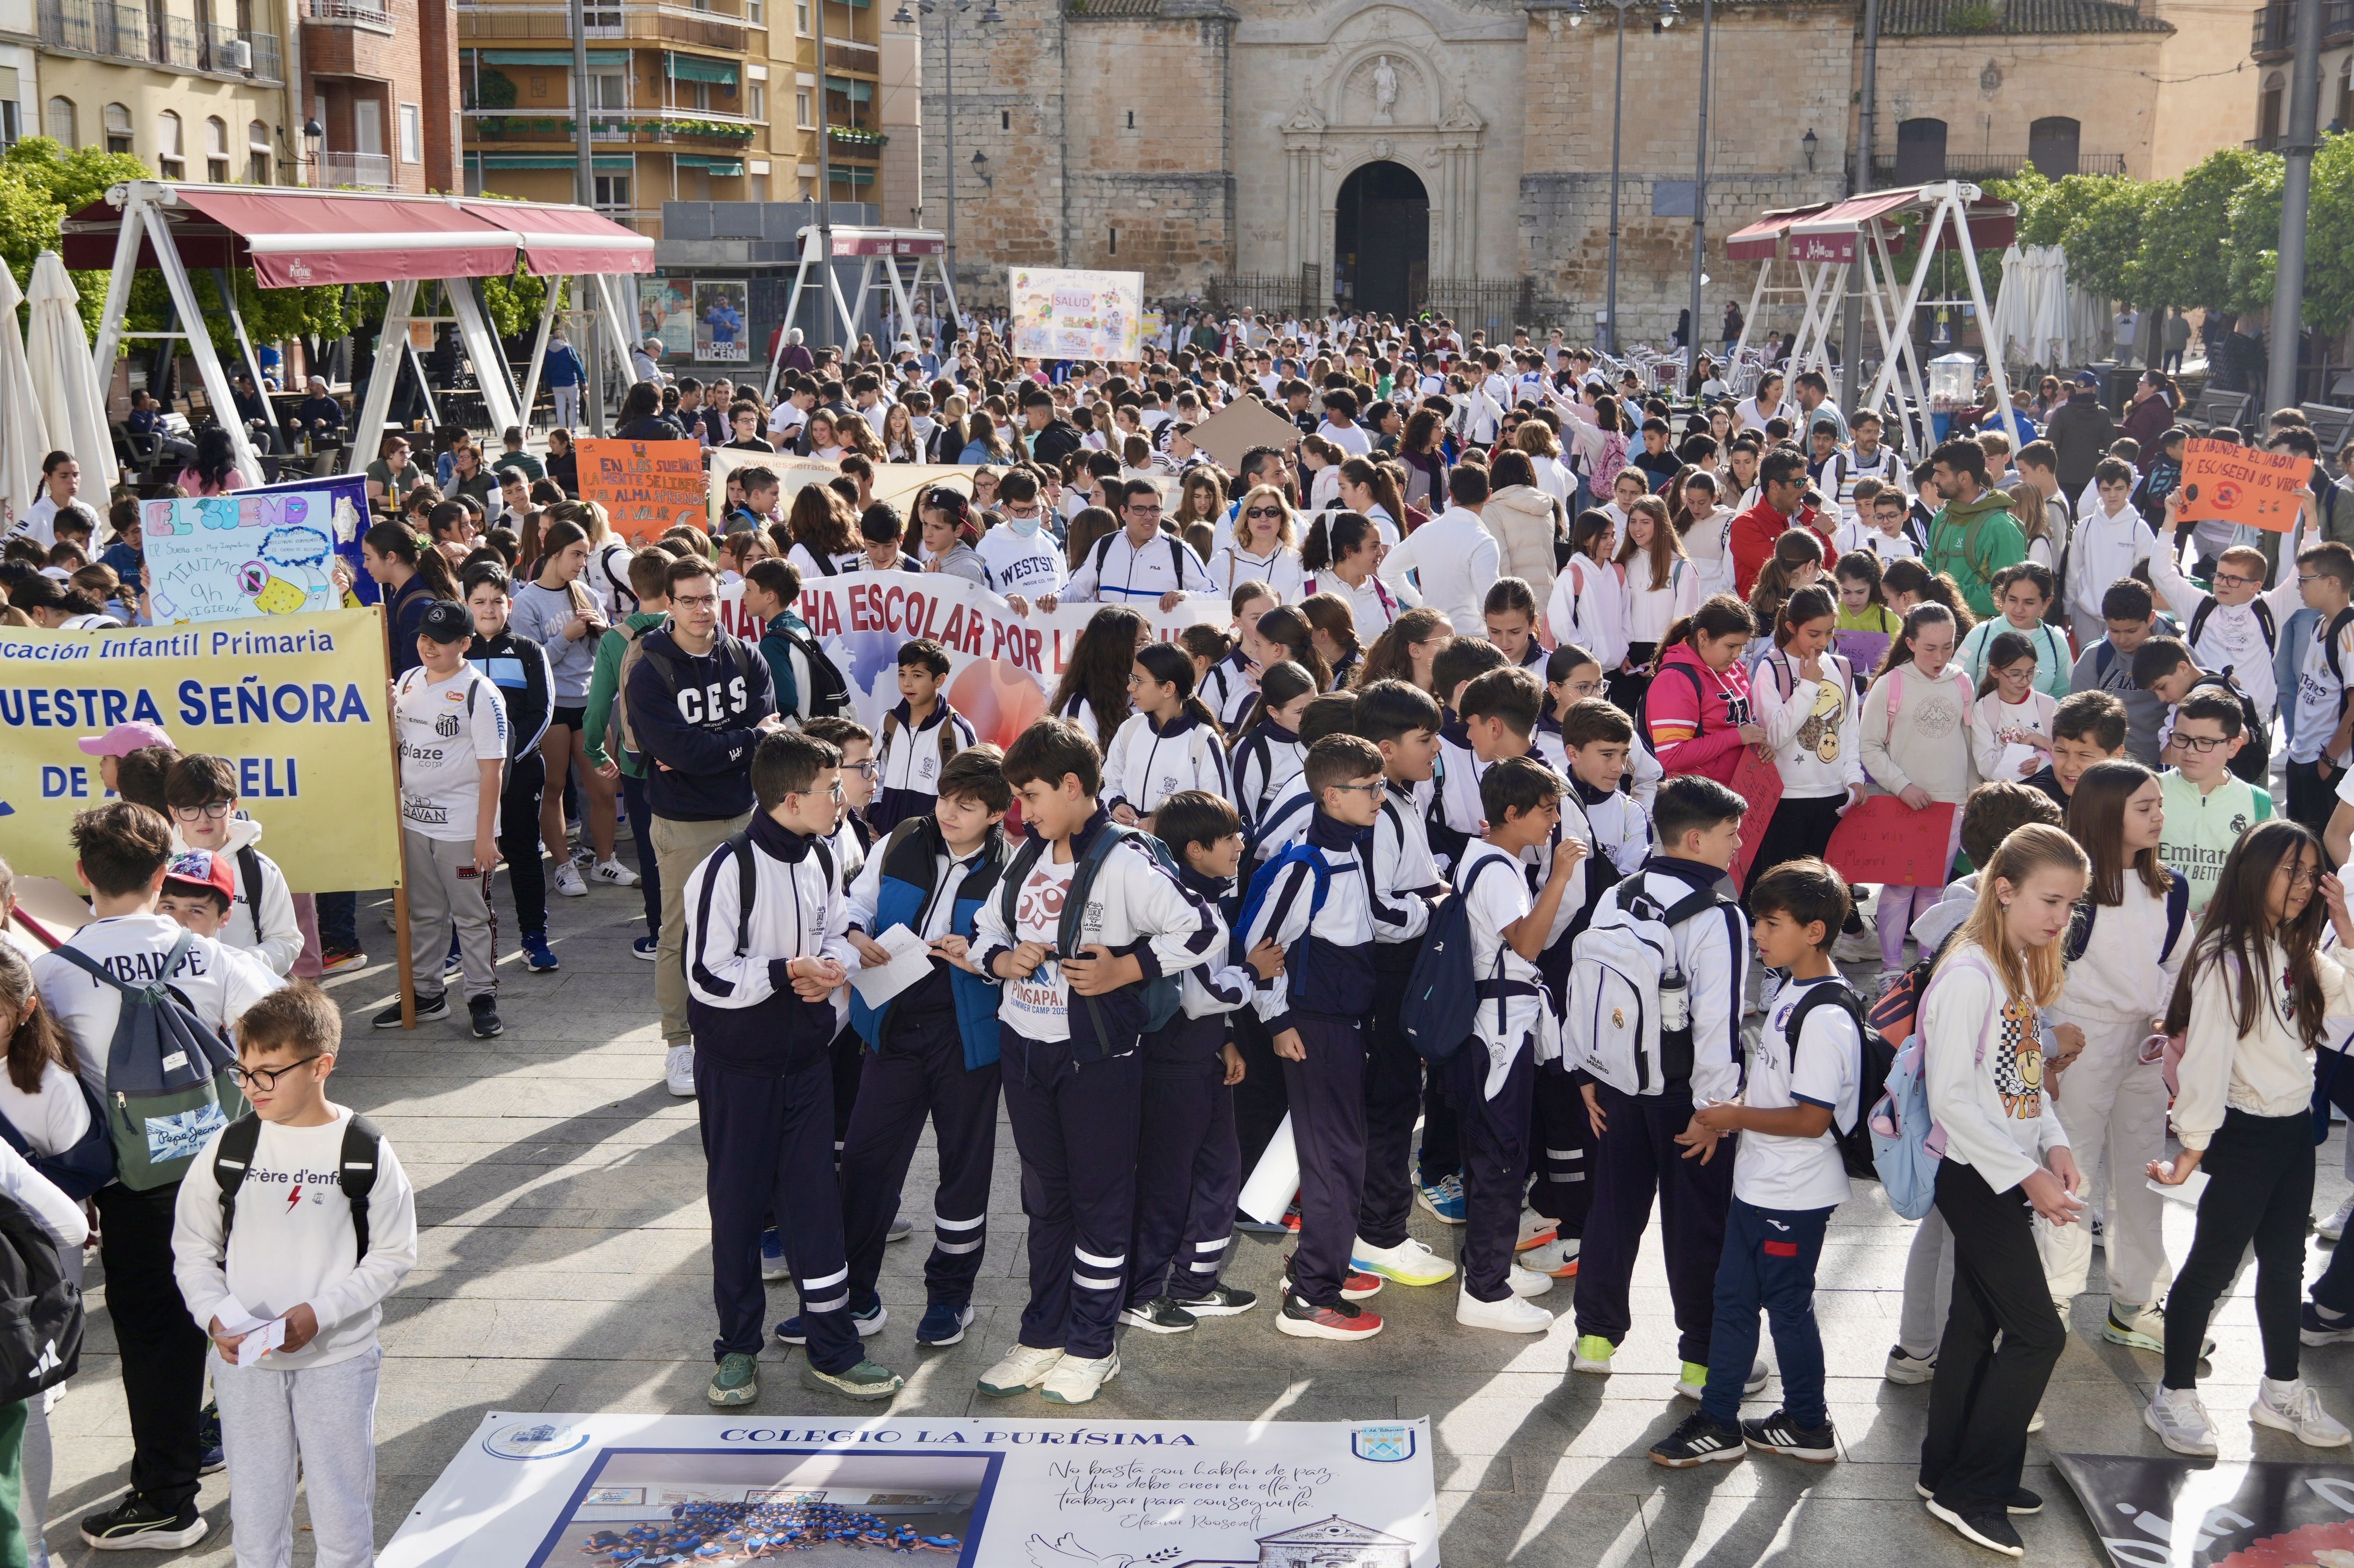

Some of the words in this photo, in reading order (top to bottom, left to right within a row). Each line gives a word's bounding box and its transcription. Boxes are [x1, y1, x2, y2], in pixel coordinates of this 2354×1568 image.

[1055, 296, 1089, 307] SALUD
[711, 341, 734, 349] CREO
[698, 350, 747, 359] LUCENA
[2203, 439, 2243, 458] ABUNDE
[2247, 449, 2259, 464] EL
[600, 458, 623, 472] EN
[628, 458, 652, 473] LOS
[2197, 459, 2256, 483] ESCASEEN
[583, 473, 600, 485] LA
[601, 472, 644, 485] MENTE
[646, 475, 661, 489] SE
[587, 489, 595, 501] Y
[597, 490, 612, 502] EL
[615, 489, 651, 502] ALMA
[652, 489, 706, 506] APRENDE
[146, 500, 193, 536] EL
[200, 494, 308, 530] SUEÑO
[614, 505, 626, 520] A
[630, 506, 670, 521] VOLAR
[149, 543, 161, 557] El
[206, 542, 219, 553] Muy
[159, 557, 243, 594] MÍNIMO
[184, 605, 242, 618] HIGIENE
[848, 584, 984, 657] ESCOLAR
[990, 618, 1043, 674] POR
[0, 642, 88, 661] cación
[100, 633, 198, 658] Infantil
[213, 630, 334, 655] Primaria
[178, 676, 370, 726] SEÑORA
[677, 675, 747, 724] CES
[42, 766, 88, 798] DE
[403, 803, 446, 821] HAVAN
[1011, 997, 1030, 1012] SUMMER
[1032, 1006, 1050, 1014] CAMP
[1586, 1058, 1609, 1075] MADRID
[1589, 1054, 1604, 1067] REAL
[158, 1131, 188, 1146] Pepe
[188, 1123, 222, 1143] Jeans
[246, 1168, 289, 1183] Frère
[720, 1428, 902, 1443] COLEGIO
[917, 1431, 969, 1443] LA
[981, 1428, 1200, 1446] PURÍSIMA
[1049, 1460, 1081, 1478] No
[1089, 1458, 1145, 1479] basta
[1151, 1467, 1187, 1476] con
[1194, 1461, 1258, 1480] hablar
[1265, 1463, 1285, 1476] de
[1071, 1476, 1118, 1493] Uno
[1127, 1476, 1172, 1490] debe
[1179, 1482, 1220, 1490] creer
[1229, 1482, 1249, 1490] en
[1259, 1476, 1292, 1497] ella
[1298, 1484, 1313, 1499] y
[1054, 1490, 1137, 1512] trabajar
[1143, 1497, 1187, 1512] para
[1194, 1492, 1314, 1515] conseguirla.
[1118, 1513, 1183, 1531] Eleanor
[1190, 1514, 1268, 1532] Roosevelt
